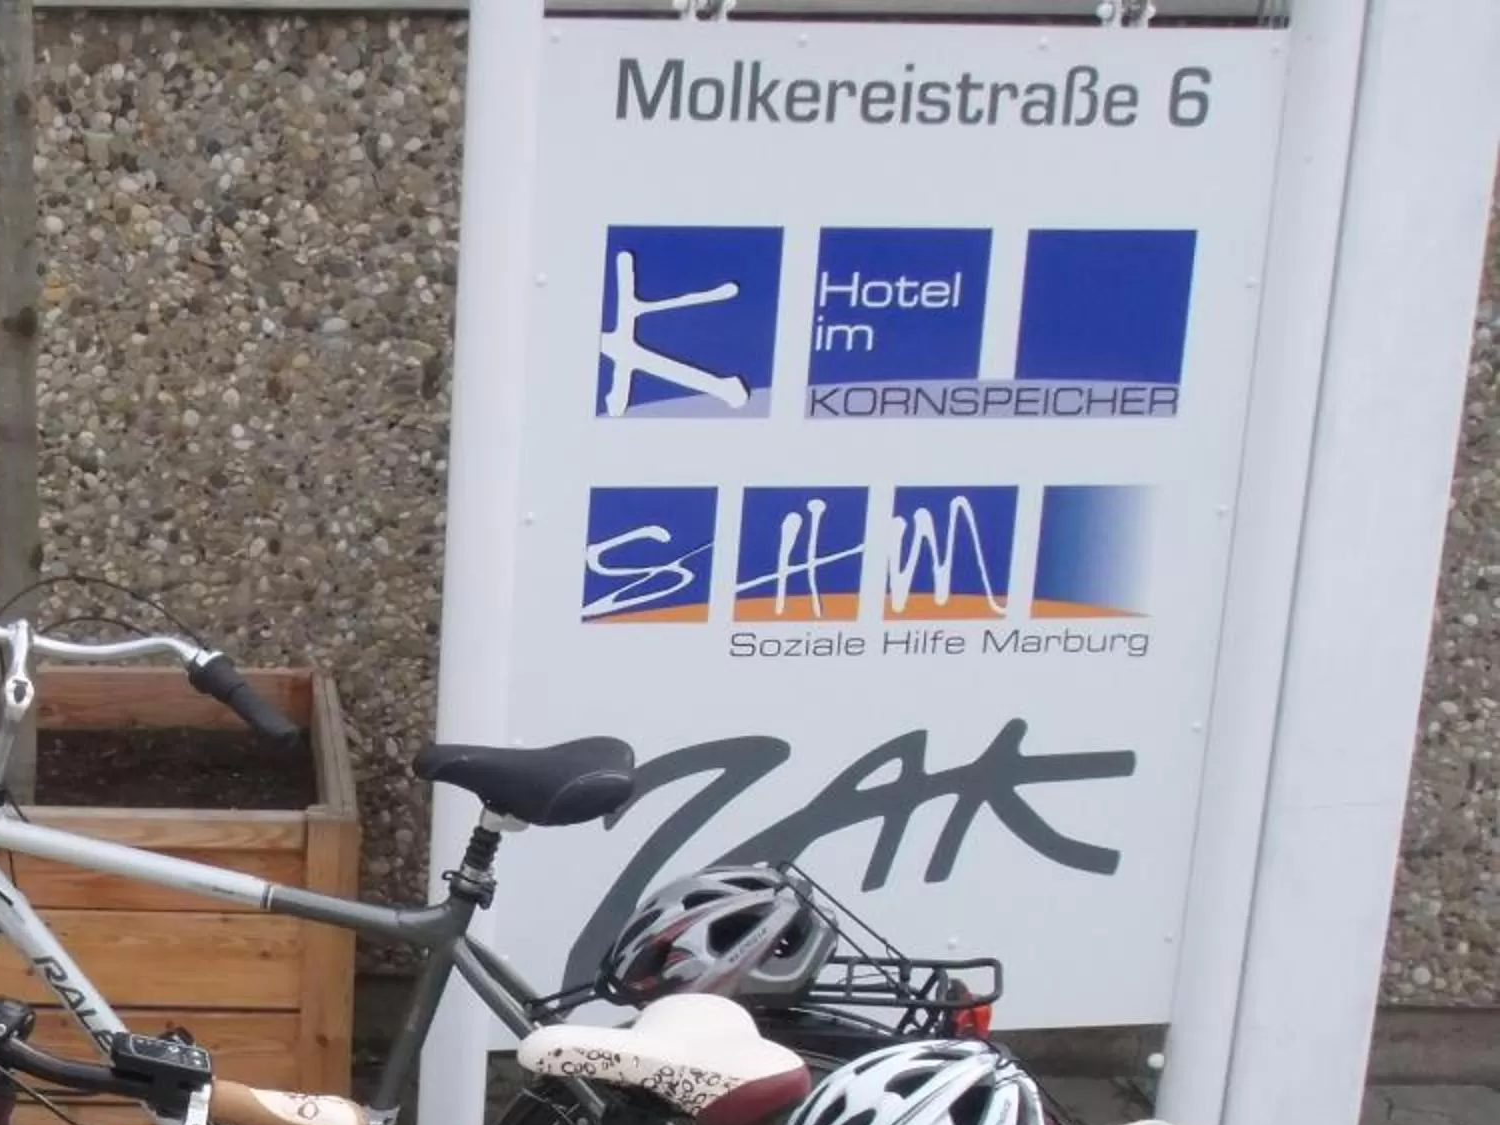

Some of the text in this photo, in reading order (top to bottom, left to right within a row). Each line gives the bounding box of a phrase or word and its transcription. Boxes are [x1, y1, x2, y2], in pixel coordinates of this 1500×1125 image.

[615, 57, 1212, 128] Molkereistraße 6
[817, 271, 962, 309] Hotel
[814, 316, 874, 352] im
[810, 386, 1180, 417] KORNSPEICHER
[729, 628, 1150, 657] Soziale Hilfe Marburg
